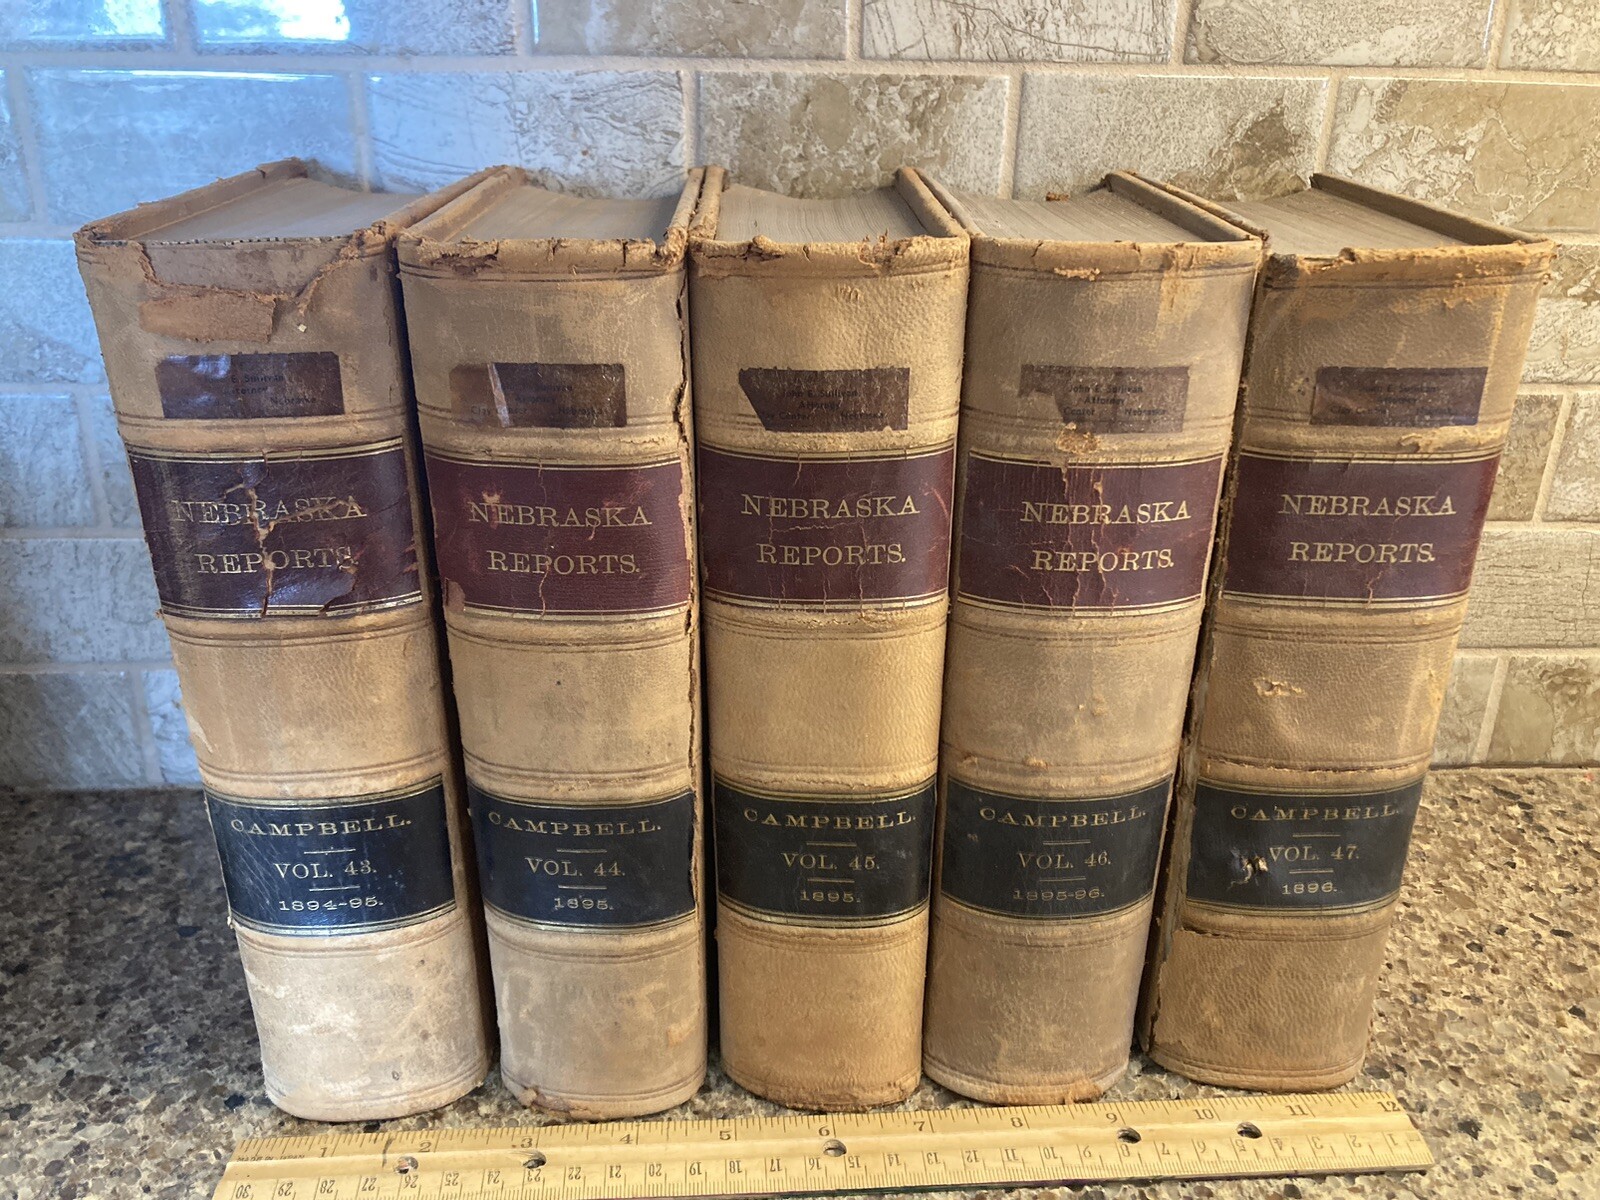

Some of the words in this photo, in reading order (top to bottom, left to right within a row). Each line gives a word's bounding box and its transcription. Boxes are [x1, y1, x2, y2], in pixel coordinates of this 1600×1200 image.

[171, 495, 367, 525] NEBRASKA
[740, 493, 920, 519] NEBRASKA
[1020, 500, 1191, 525] NEBRASKA
[1278, 494, 1457, 517] NEBRASKA
[467, 502, 653, 527] NEBRASKA
[756, 543, 906, 566] REPORTS.
[1288, 542, 1436, 564] REPORTS.
[486, 550, 640, 575] REPORTS.
[1030, 549, 1174, 573] REPORTS.
[744, 808, 916, 829] CAMPBELL.
[979, 806, 1147, 828] CAMPBELL.
[1230, 804, 1400, 821] CAMPBELL.
[230, 814, 412, 837] CAMPBELL.
[488, 811, 661, 836] CAMPBELL.
[1018, 852, 1074, 869] VOL.
[1084, 850, 1112, 868] 46.
[1269, 846, 1320, 862] VOL.
[1330, 845, 1360, 860] 47.
[524, 857, 583, 876] VOL.
[594, 862, 626, 876] 44.
[781, 852, 838, 870] VOL.
[849, 855, 880, 870] 45.
[275, 862, 333, 879] VOL.
[344, 860, 377, 876] 43.
[319, 1147, 328, 1158] 1
[418, 1142, 432, 1153] 2
[520, 1138, 533, 1148] 3
[619, 1134, 633, 1144] 4
[719, 1130, 732, 1140] 5
[818, 1125, 830, 1136] 6
[913, 1121, 925, 1131] 7
[1010, 1117, 1023, 1128] 8
[1106, 1112, 1118, 1124] 9
[1194, 1109, 1215, 1120] 10
[1285, 1105, 1309, 1116] 11
[1377, 1101, 1401, 1112] 12
[1236, 1139, 1246, 1152] 5
[1273, 1138, 1283, 1151] 4
[1313, 1137, 1324, 1150] 3
[1351, 1135, 1362, 1148] 2
[1388, 1133, 1399, 1146] 1
[1043, 1147, 1059, 1160] 10
[1082, 1145, 1092, 1158] 9
[1121, 1144, 1131, 1157] 8
[1161, 1142, 1171, 1155] 7
[1197, 1141, 1207, 1154] 6
[848, 1156, 861, 1168] 15
[887, 1153, 901, 1166] 14
[926, 1152, 941, 1165] 13
[965, 1150, 980, 1163] 12
[1004, 1149, 1019, 1162] 11
[648, 1163, 662, 1177] 20
[689, 1162, 703, 1175] 19
[729, 1160, 743, 1174] 18
[769, 1158, 783, 1172] 17
[808, 1157, 822, 1170] 16
[445, 1172, 460, 1186] 25
[487, 1171, 500, 1184] 24
[527, 1168, 541, 1182] 23
[568, 1167, 582, 1180] 22
[609, 1165, 622, 1179] 21
[319, 1180, 336, 1194] 28
[361, 1178, 377, 1192] 27
[404, 1174, 419, 1189] 26
[235, 1184, 251, 1199] 30
[277, 1182, 293, 1196] 29
